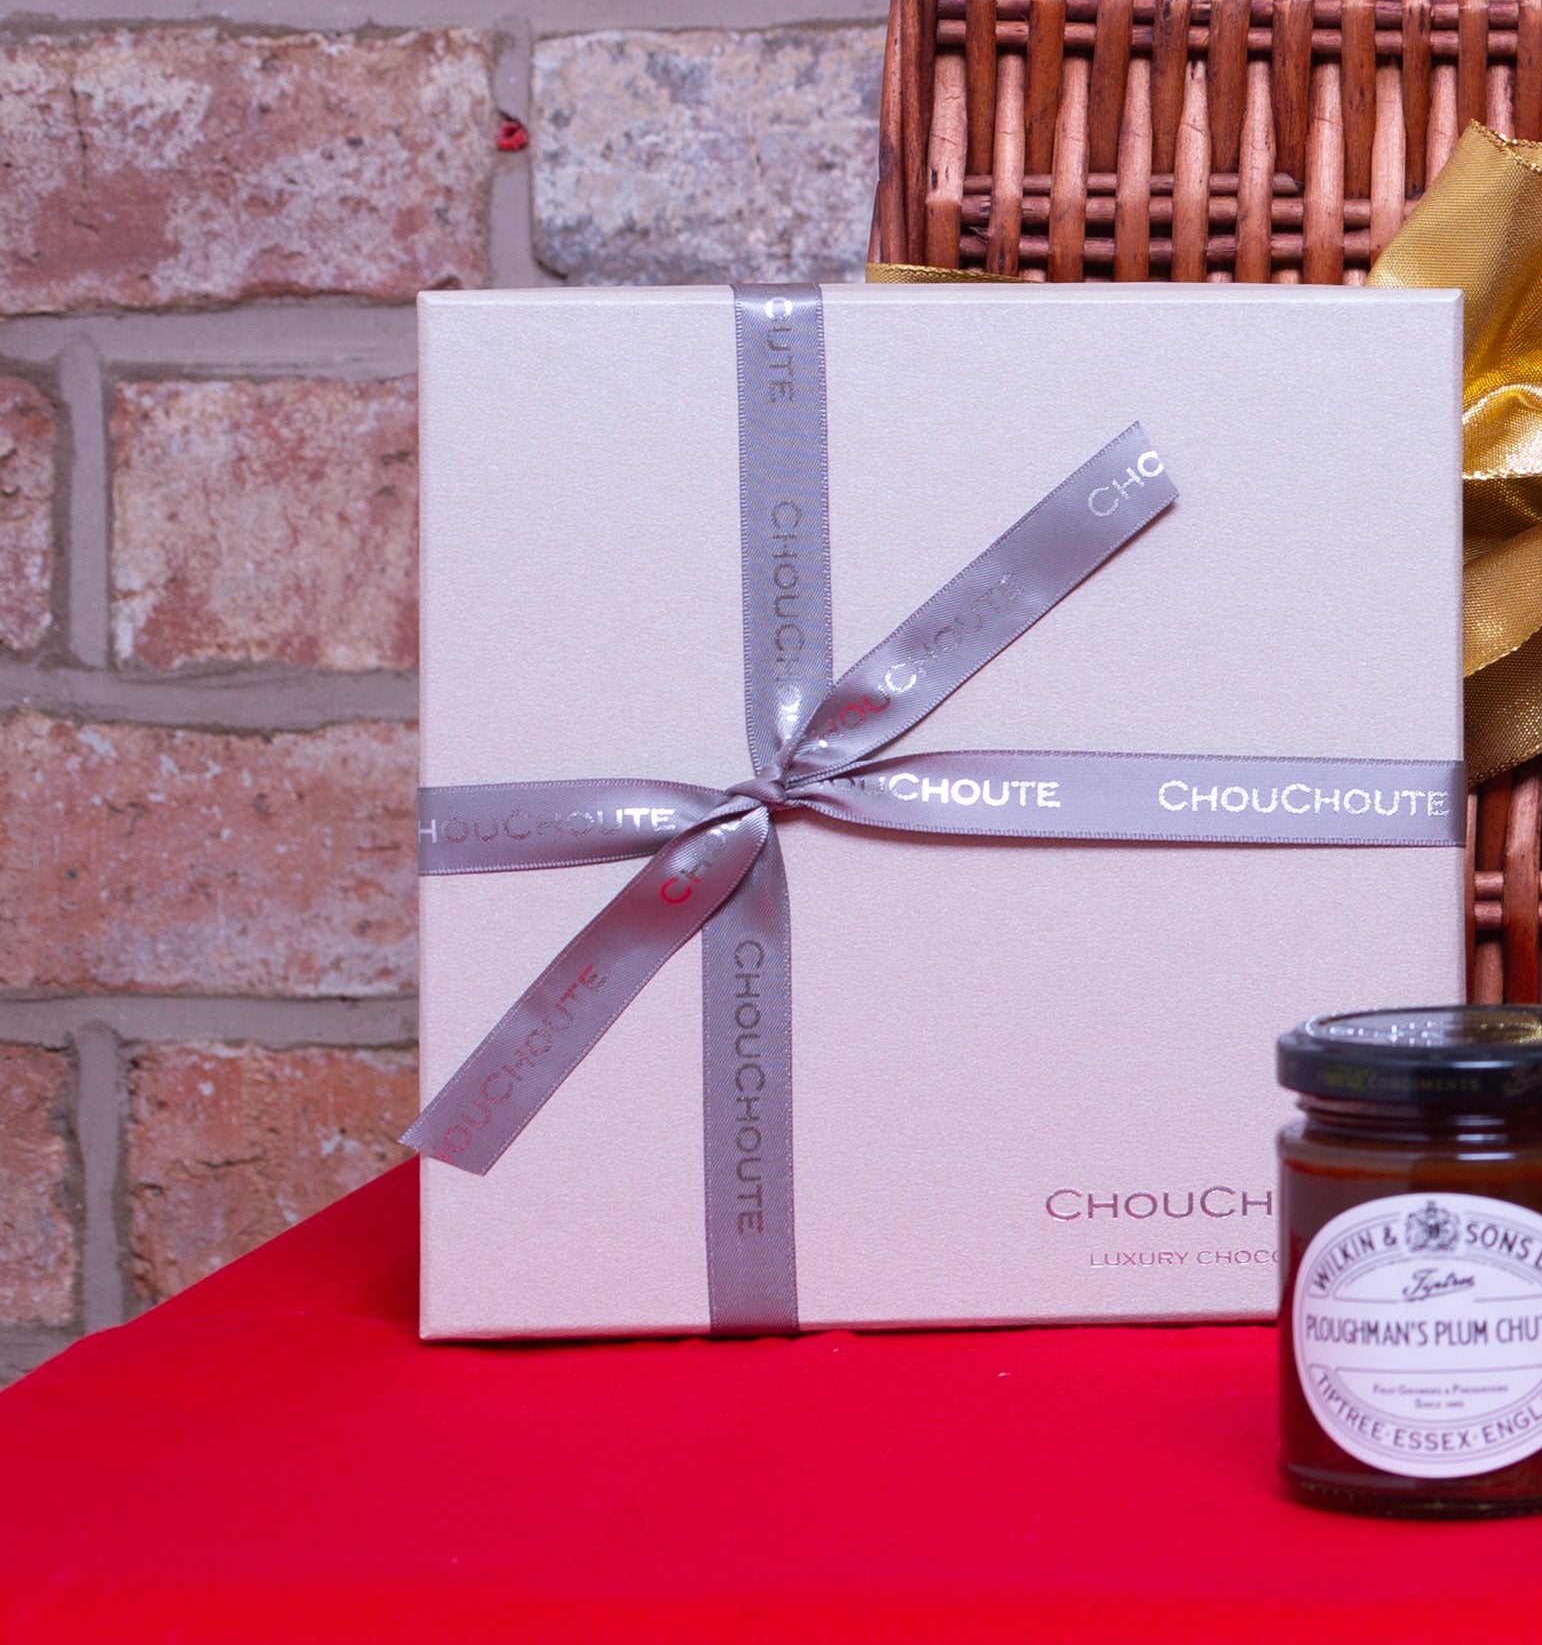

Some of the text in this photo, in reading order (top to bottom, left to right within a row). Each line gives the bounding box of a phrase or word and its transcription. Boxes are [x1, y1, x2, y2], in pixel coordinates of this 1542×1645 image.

[1090, 1251, 1189, 1267] LUXURY
[1312, 1227, 1375, 1292] WILKIN
[1382, 1227, 1399, 1247] &
[1464, 1223, 1530, 1262] SONS
[1306, 1313, 1428, 1347] PLOUGHMAN'S
[1434, 1319, 1488, 1346] PLUM
[1317, 1371, 1385, 1440] TIPTREE
[1392, 1428, 1472, 1452] ESSEX
